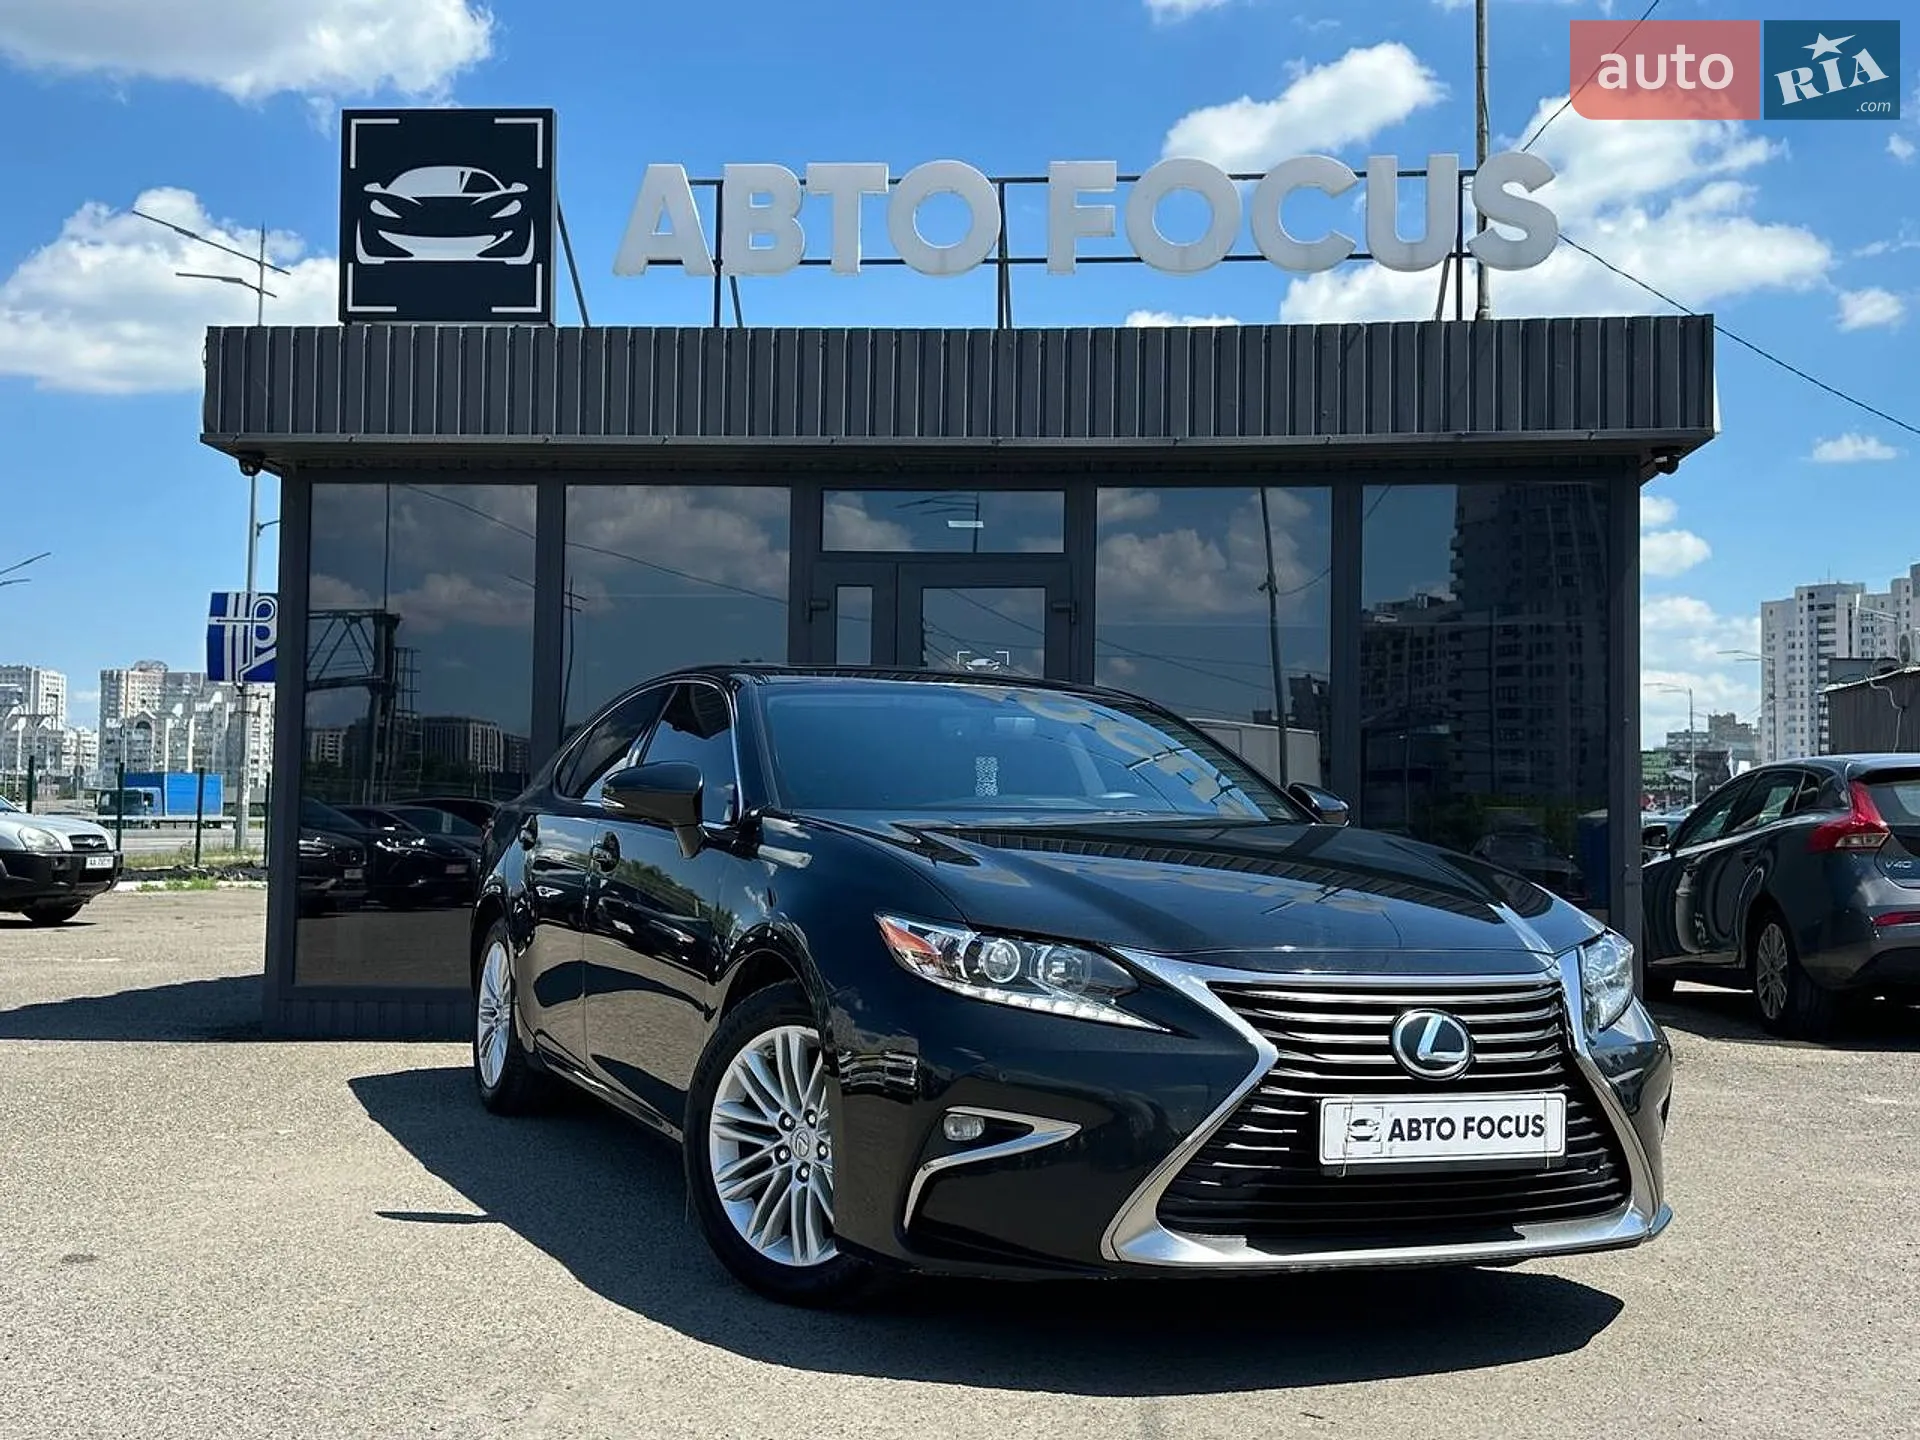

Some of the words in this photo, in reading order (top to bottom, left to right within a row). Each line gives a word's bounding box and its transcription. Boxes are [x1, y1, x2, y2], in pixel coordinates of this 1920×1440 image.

[612, 159, 1001, 277] АВТО
[1047, 153, 1560, 275] FOCUS
[1388, 1117, 1456, 1142] АВТО
[1462, 1114, 1546, 1140] FOCUS
